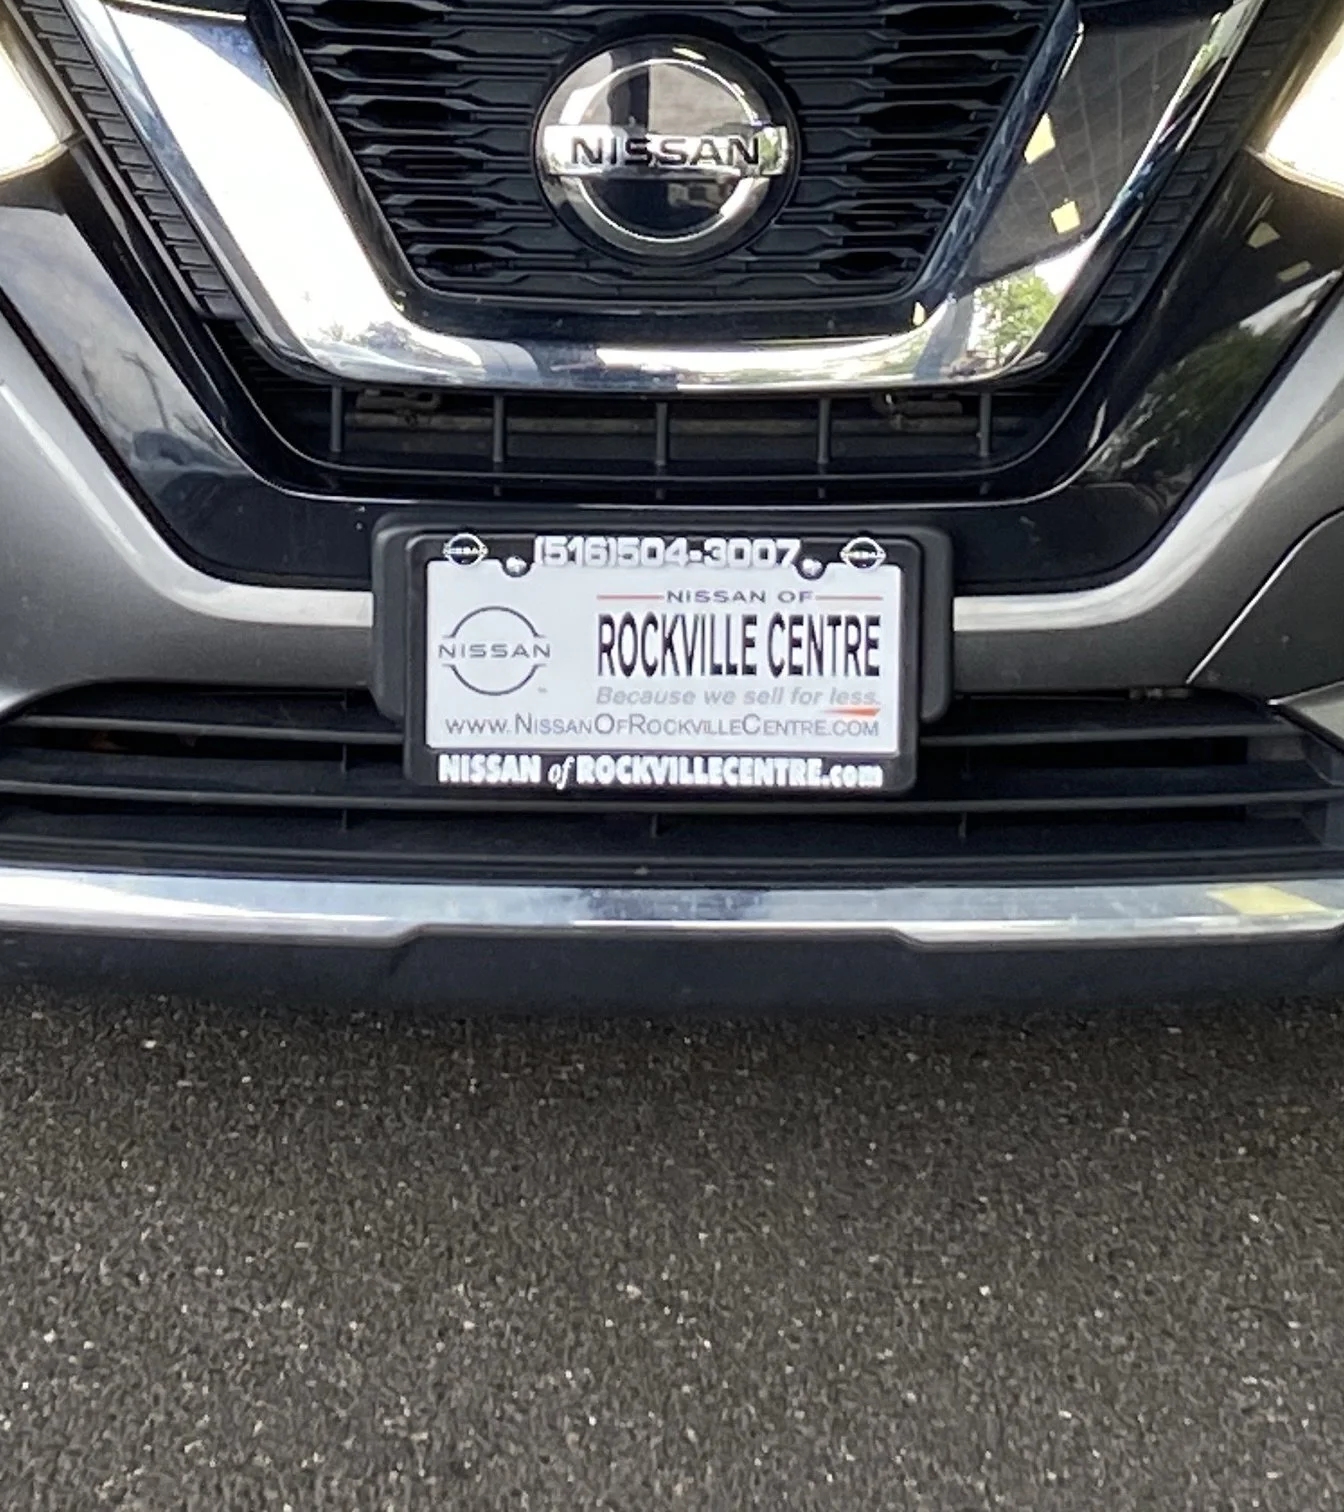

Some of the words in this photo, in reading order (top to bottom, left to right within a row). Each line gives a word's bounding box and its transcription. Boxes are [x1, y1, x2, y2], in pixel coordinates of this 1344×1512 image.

[571, 136, 759, 166] NISSAN
[666, 590, 766, 604] NISSAN
[777, 590, 813, 604] OF
[438, 643, 551, 659] NISSAN
[597, 612, 757, 677] ROCKVILLE
[767, 612, 881, 678] CENTRE
[596, 686, 696, 705] Because
[704, 691, 736, 705] we
[743, 686, 784, 705] sell
[791, 687, 823, 705] for
[829, 687, 881, 705] less.
[438, 754, 542, 783] NISSAN
[547, 755, 576, 790] of
[576, 755, 884, 788] ROCKVILLECENTRE.com
